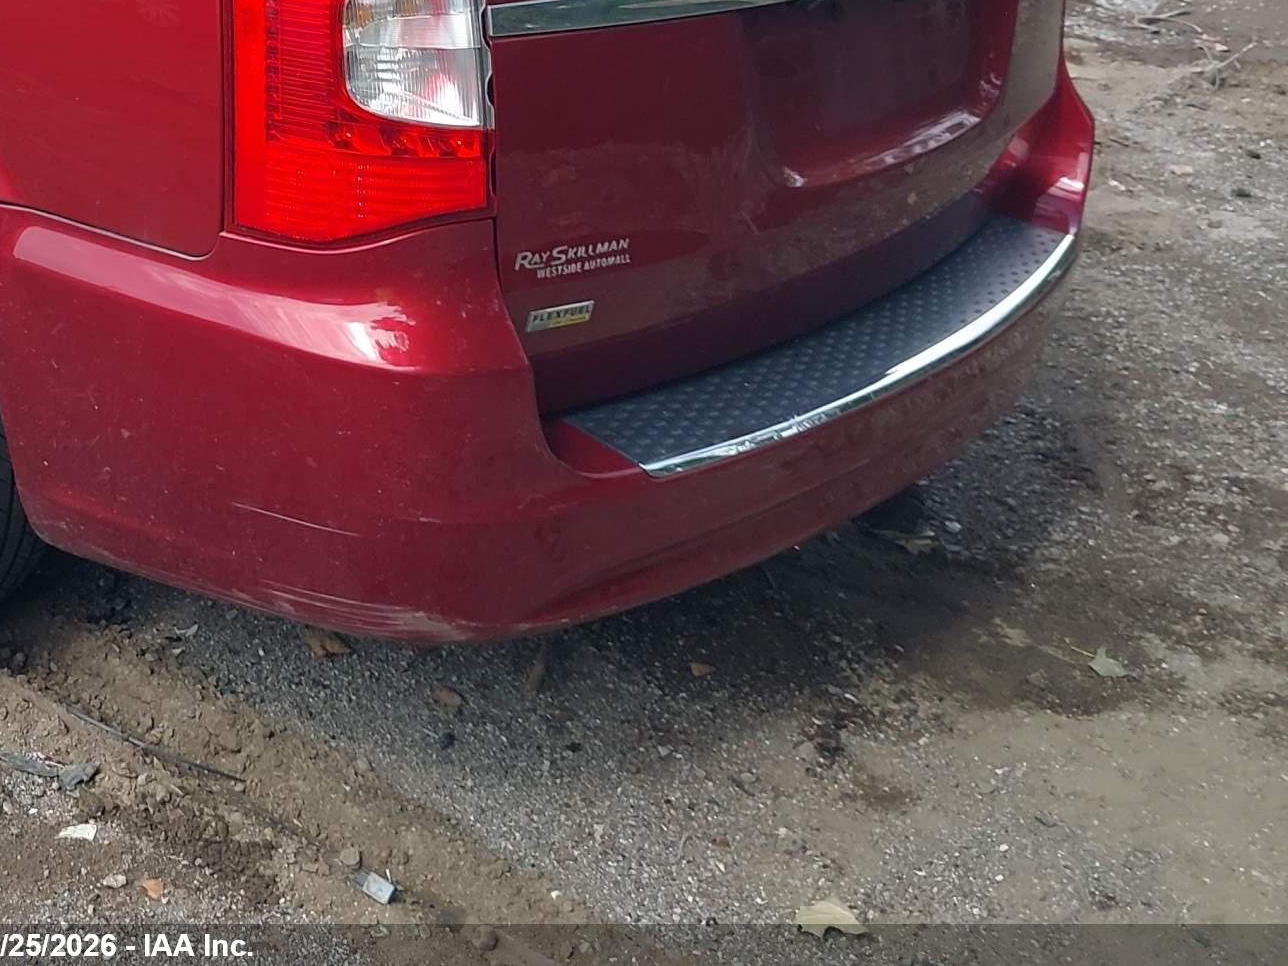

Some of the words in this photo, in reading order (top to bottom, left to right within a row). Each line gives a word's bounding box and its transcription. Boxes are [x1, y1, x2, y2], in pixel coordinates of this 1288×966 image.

[515, 251, 550, 271] RAY
[551, 238, 630, 265] SKILLMAN
[537, 262, 582, 279] WESTSIDE
[584, 254, 631, 270] AUTOMALL
